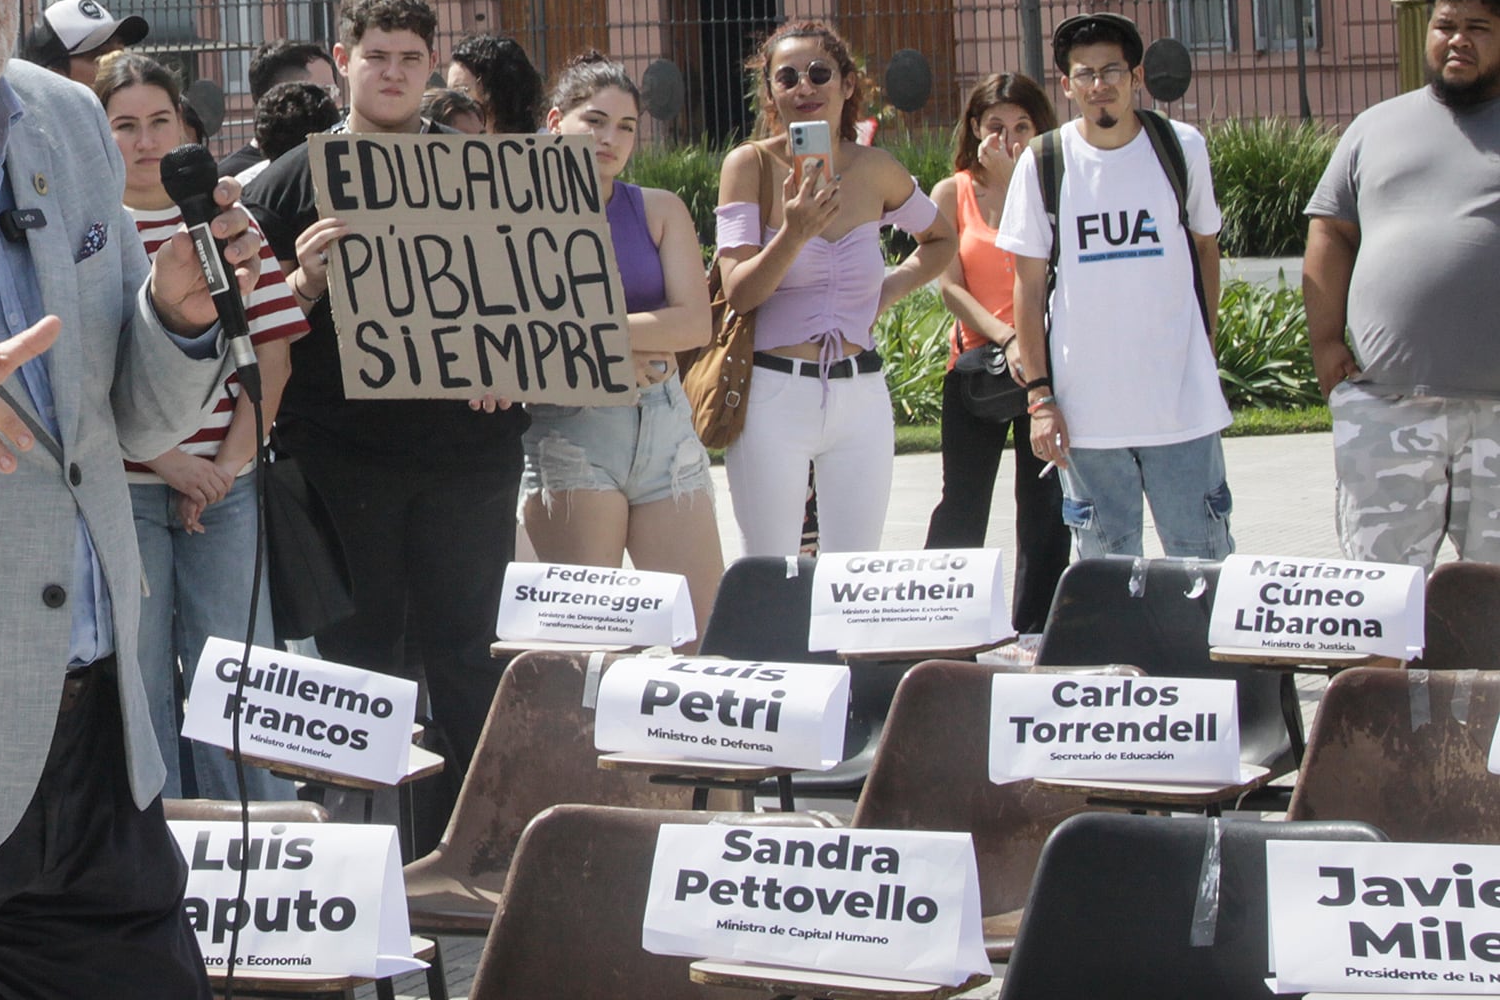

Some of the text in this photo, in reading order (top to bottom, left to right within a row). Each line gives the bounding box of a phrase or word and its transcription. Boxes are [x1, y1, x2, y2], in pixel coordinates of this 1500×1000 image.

[1076, 209, 1161, 250] FUA
[546, 566, 641, 587] Federico
[845, 553, 968, 574] Gerardo
[1250, 560, 1386, 581] Mariano
[515, 585, 664, 613] Sturzenegger
[830, 577, 975, 603] Werthein
[1259, 581, 1365, 607] Cúneo
[539, 620, 593, 630] Transformación
[608, 625, 632, 633] Estado
[577, 613, 628, 624] Desregulación
[847, 616, 879, 624] Comercio
[881, 615, 927, 623] Internacional
[1234, 606, 1383, 638] Libarona
[1261, 640, 1356, 651] Ministro de Justicia
[667, 661, 788, 682] Luis
[215, 657, 394, 719] Guillermo
[1052, 680, 1179, 708] Carlos
[640, 679, 787, 733] Petri
[223, 693, 370, 750] Francos
[1009, 713, 1217, 744] Torrendell
[250, 733, 332, 759] Ministro del Interior
[647, 727, 773, 752] Ministro de Defensa
[1050, 750, 1174, 761] Secretario de Educación
[191, 824, 315, 871] Luis
[722, 829, 901, 875] Sandra
[674, 869, 939, 925] Pettovello
[1316, 863, 1500, 909] Javie
[183, 890, 356, 944] aputo
[716, 918, 889, 945] Ministra de Capital Humano
[1348, 916, 1500, 963] Mile
[247, 953, 312, 966] Economía
[1345, 967, 1438, 981] Presidente
[1443, 971, 1465, 982] de
[1469, 972, 1485, 983] la
